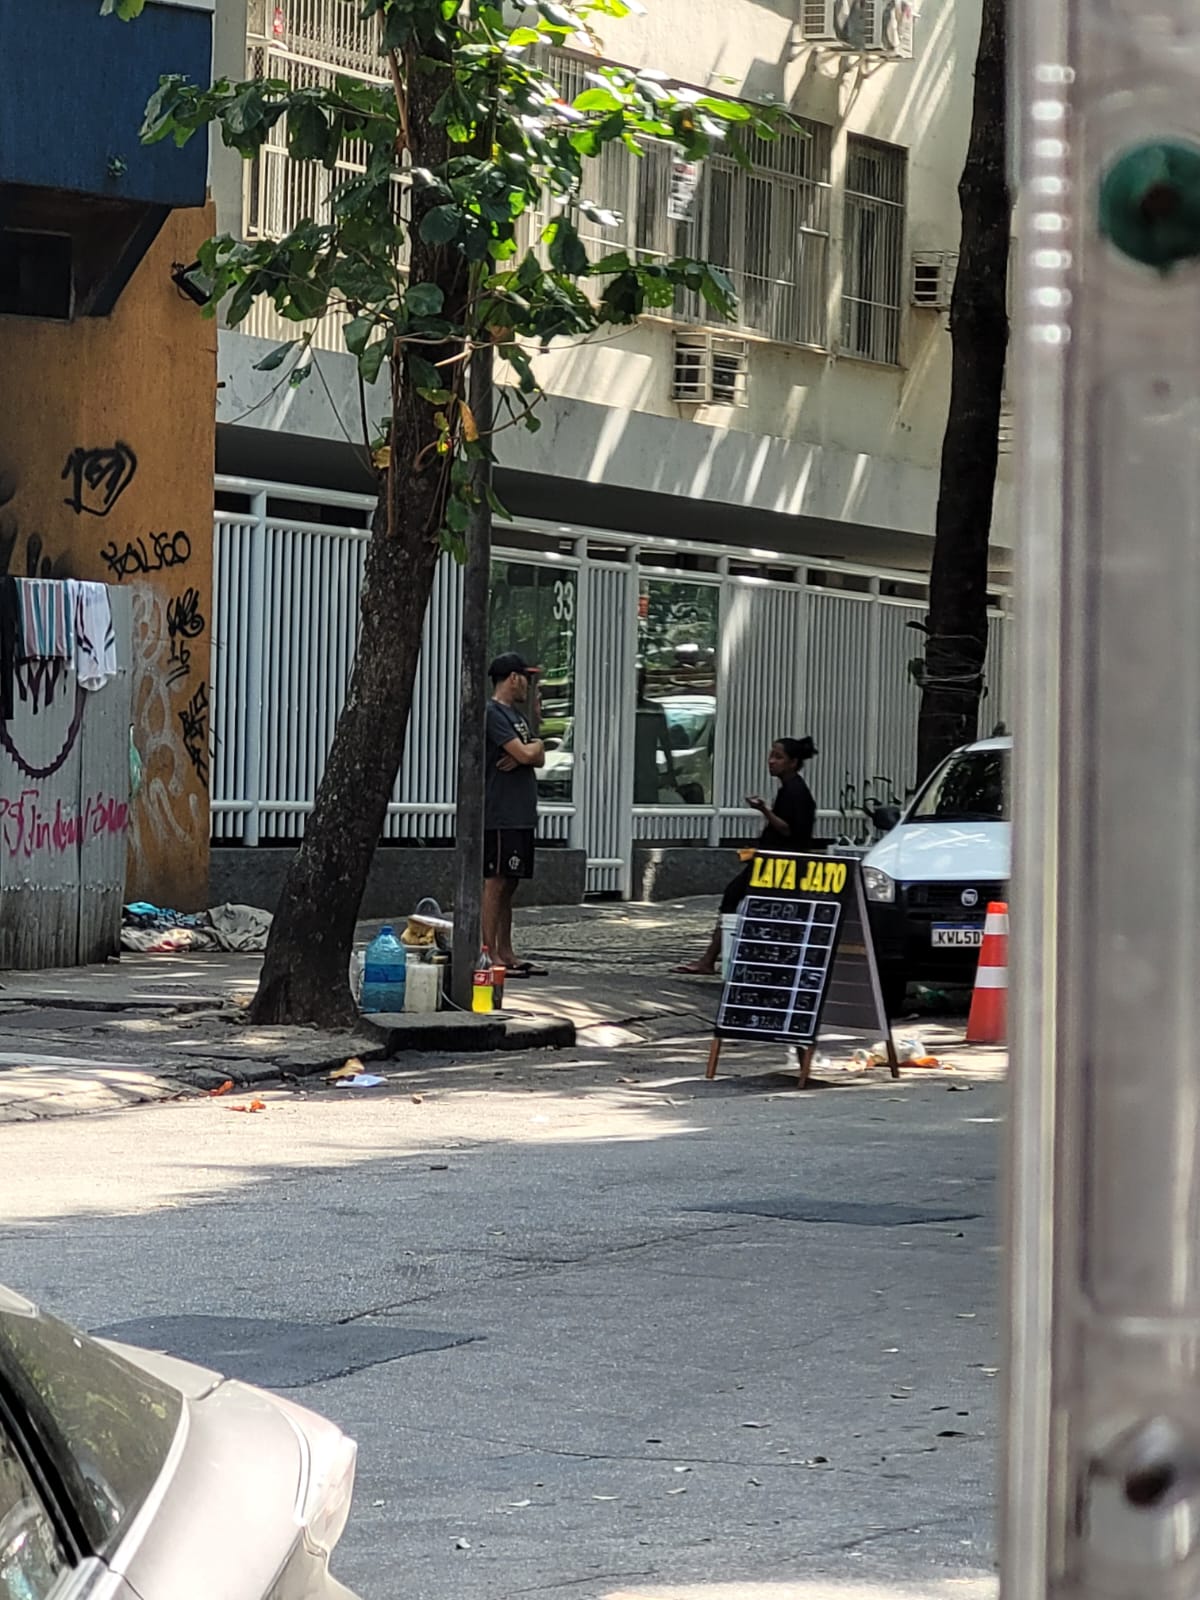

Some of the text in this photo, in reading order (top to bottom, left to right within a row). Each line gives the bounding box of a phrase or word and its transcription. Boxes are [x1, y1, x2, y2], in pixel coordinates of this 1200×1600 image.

[553, 580, 575, 621] 33
[749, 857, 848, 894] LAVA JATO
[938, 930, 985, 945] KWL5D
